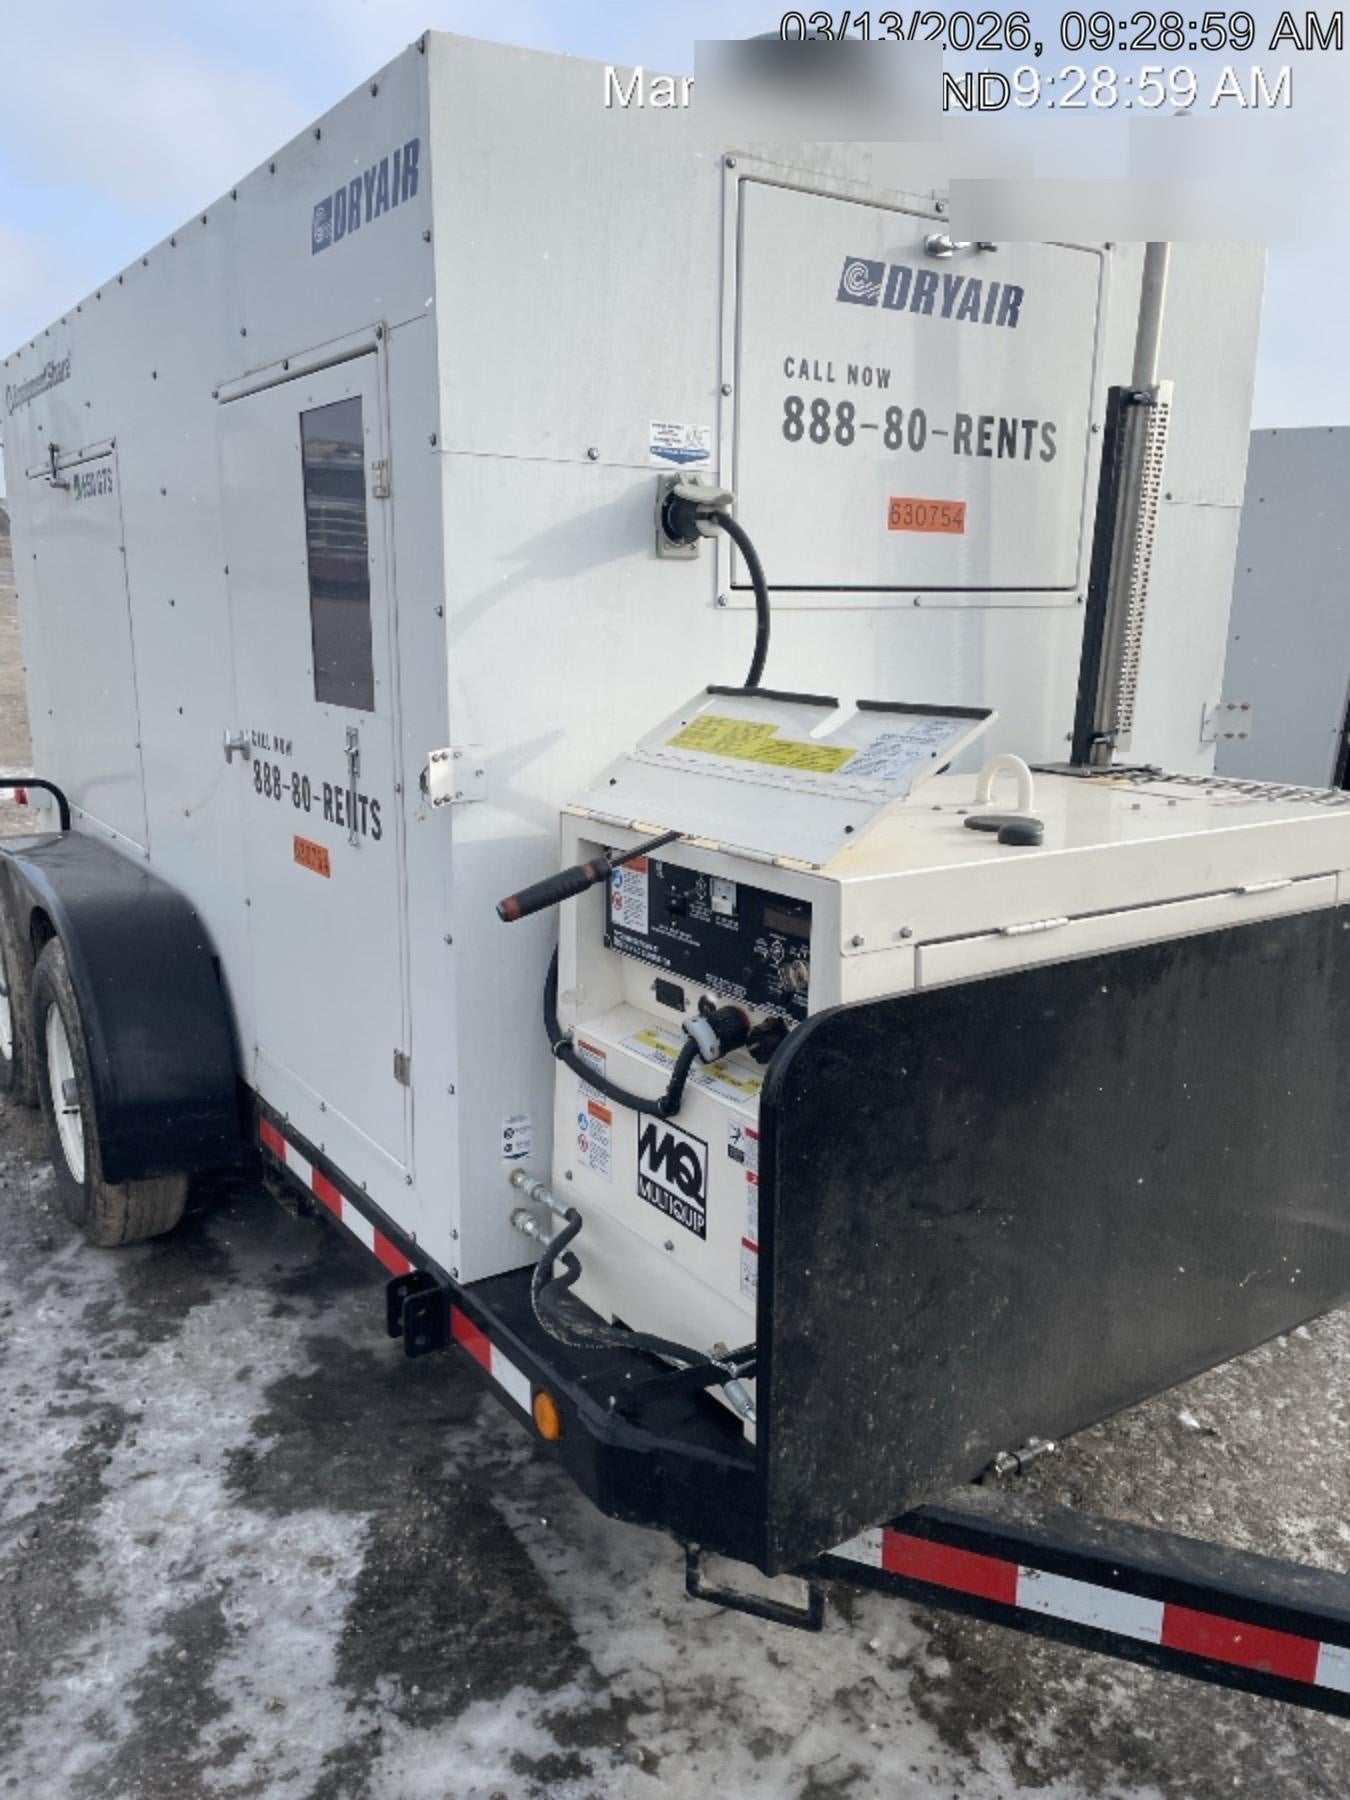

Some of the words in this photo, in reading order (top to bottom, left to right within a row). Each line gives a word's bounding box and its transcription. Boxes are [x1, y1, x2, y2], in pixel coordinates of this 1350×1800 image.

[333, 137, 421, 243] DRYAIR
[881, 263, 1025, 329] DRYAIR
[783, 356, 836, 383] CALL
[846, 363, 892, 389] NOW
[782, 395, 1058, 463] 888-80-RENTS
[890, 503, 963, 529] 630754
[253, 759, 383, 841] 888-80-RENTS
[639, 1121, 706, 1203] MQ
[640, 1175, 706, 1234] MULTIQUIP
